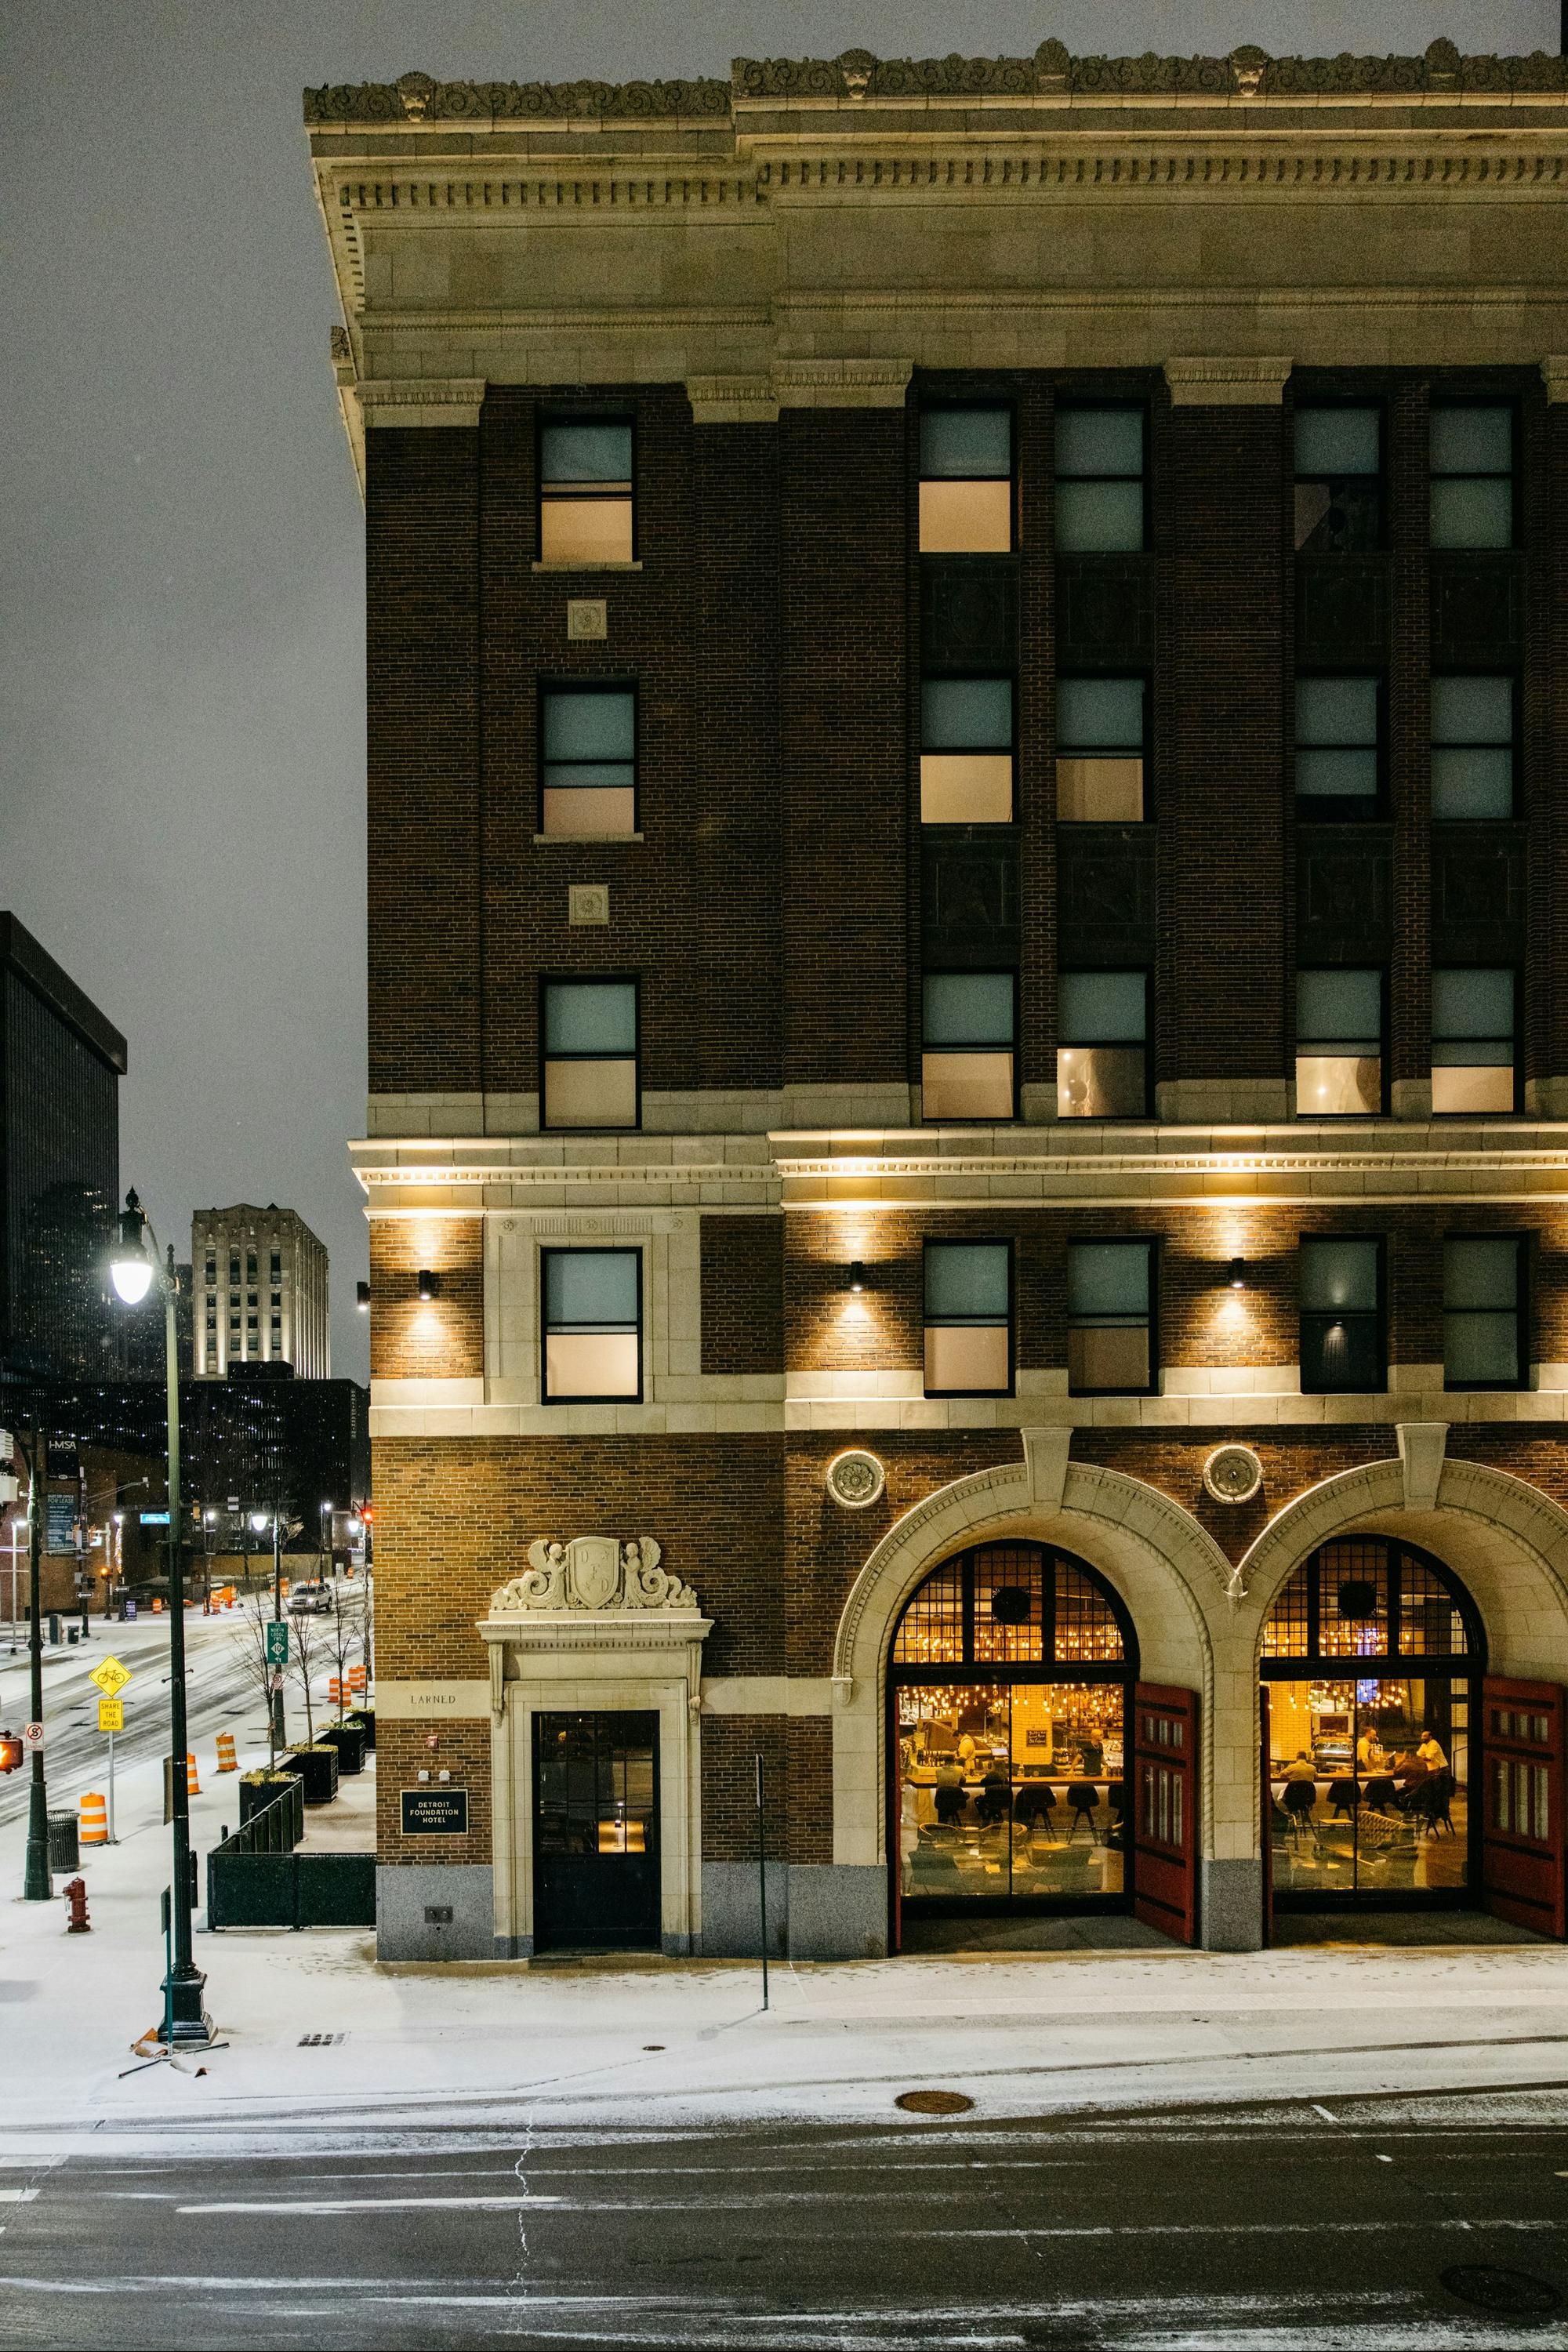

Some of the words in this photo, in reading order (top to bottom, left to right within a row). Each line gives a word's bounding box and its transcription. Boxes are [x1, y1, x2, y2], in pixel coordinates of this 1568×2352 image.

[581, 1548, 589, 1563] D
[601, 1578, 609, 1593] D
[411, 1695, 456, 1704] LARNED
